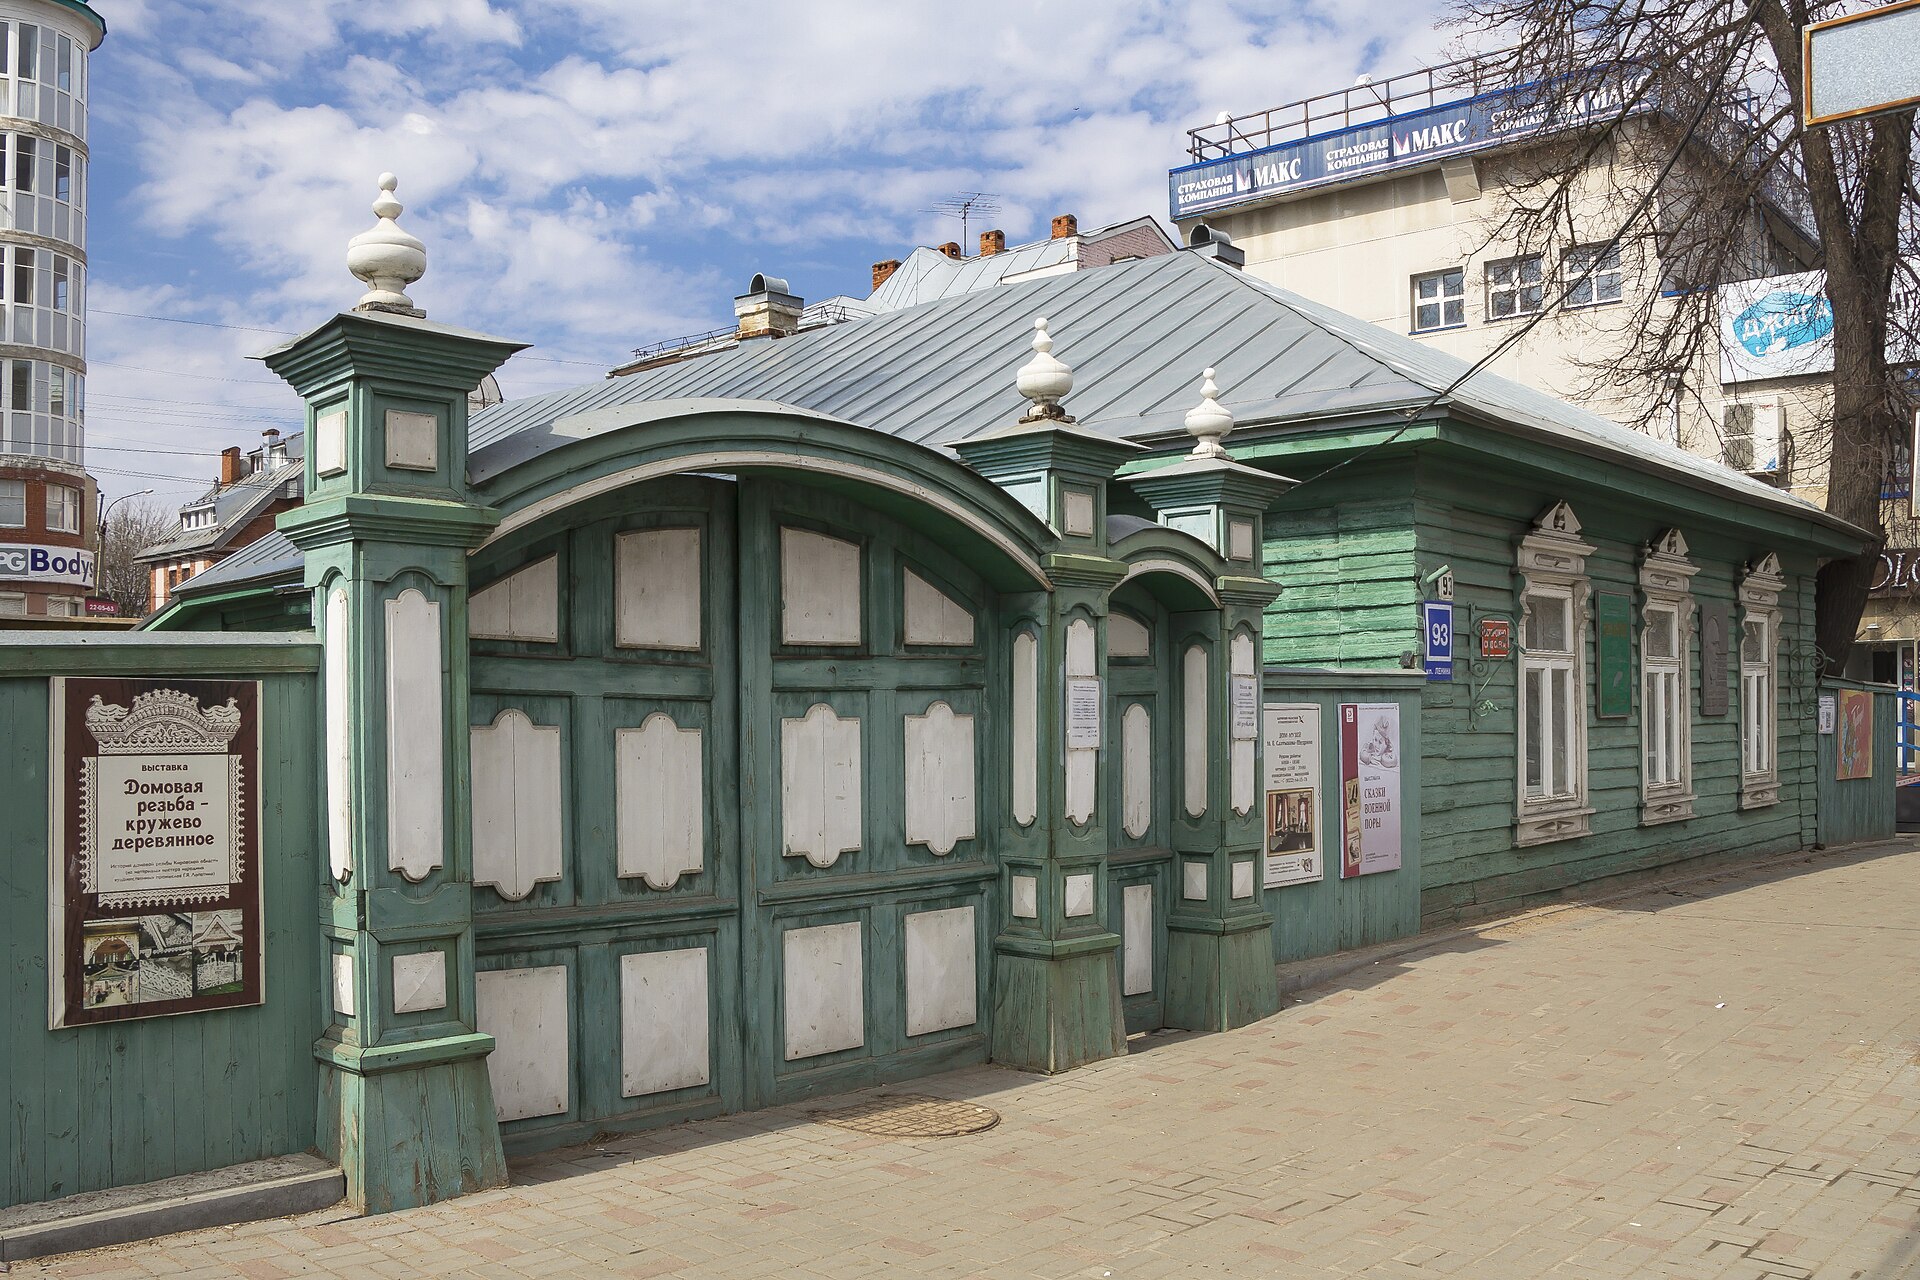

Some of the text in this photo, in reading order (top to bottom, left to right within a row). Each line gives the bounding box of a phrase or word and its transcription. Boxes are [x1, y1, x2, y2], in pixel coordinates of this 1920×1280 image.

[1326, 119, 1467, 161] СТРАХОВАЯ МАКС
[1327, 150, 1389, 171] КОМПАНИЯ
[1178, 158, 1302, 195] СТРАХОВАЯ МАКС
[1178, 184, 1233, 204] КОМПАНИЯ
[1442, 576, 1452, 596] 93
[1432, 623, 1448, 646] 93
[141, 763, 188, 772] выставка
[123, 779, 204, 795] Домовая
[1364, 786, 1386, 798] СКАЗКИ
[137, 795, 195, 816] резьба
[1364, 798, 1391, 814] ВОЕННОЙ
[125, 817, 202, 834] кружево
[1364, 817, 1381, 829] ПОРЫ
[111, 834, 215, 852] деревянное
